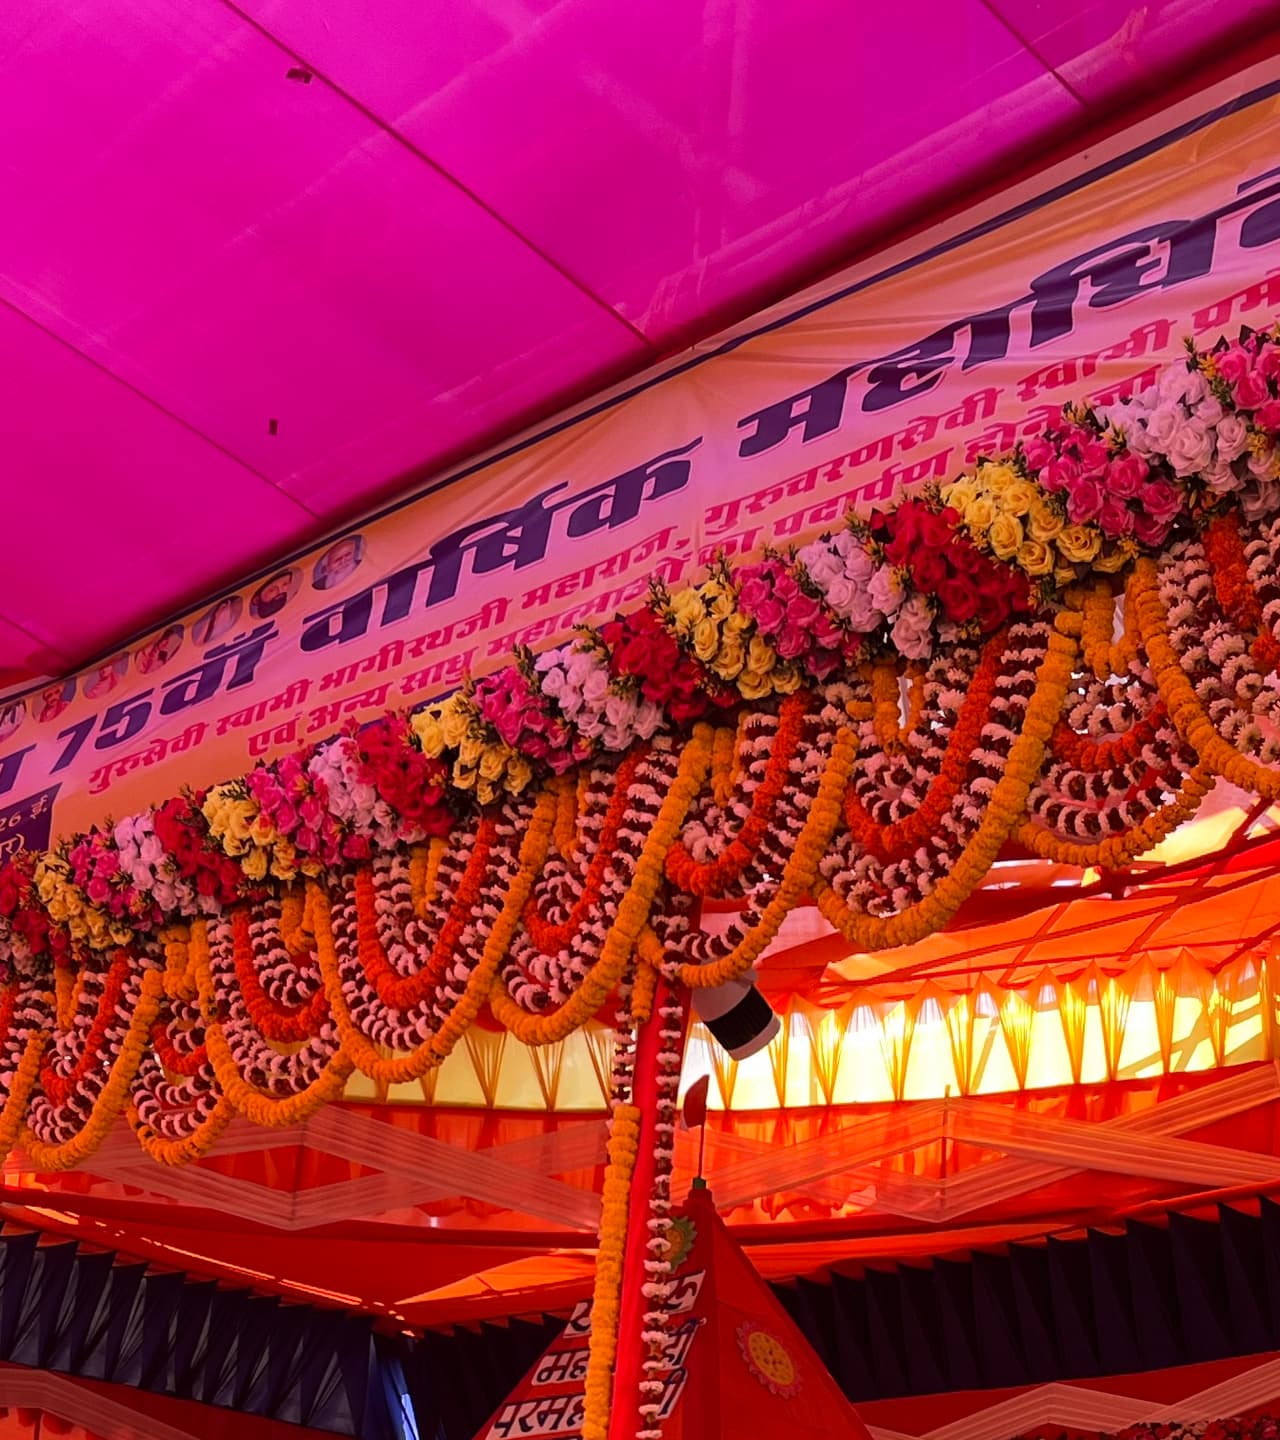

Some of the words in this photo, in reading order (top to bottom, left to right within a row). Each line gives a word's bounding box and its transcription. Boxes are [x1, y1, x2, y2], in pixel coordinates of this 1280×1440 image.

[216, 678, 313, 738] स्वामी
[522, 525, 692, 607] महाराज,
[1016, 319, 1178, 402] स्वामी
[300, 436, 703, 653] वार्षिक
[307, 681, 393, 734] अन्य
[400, 646, 479, 695] साधु
[699, 527, 765, 566] का
